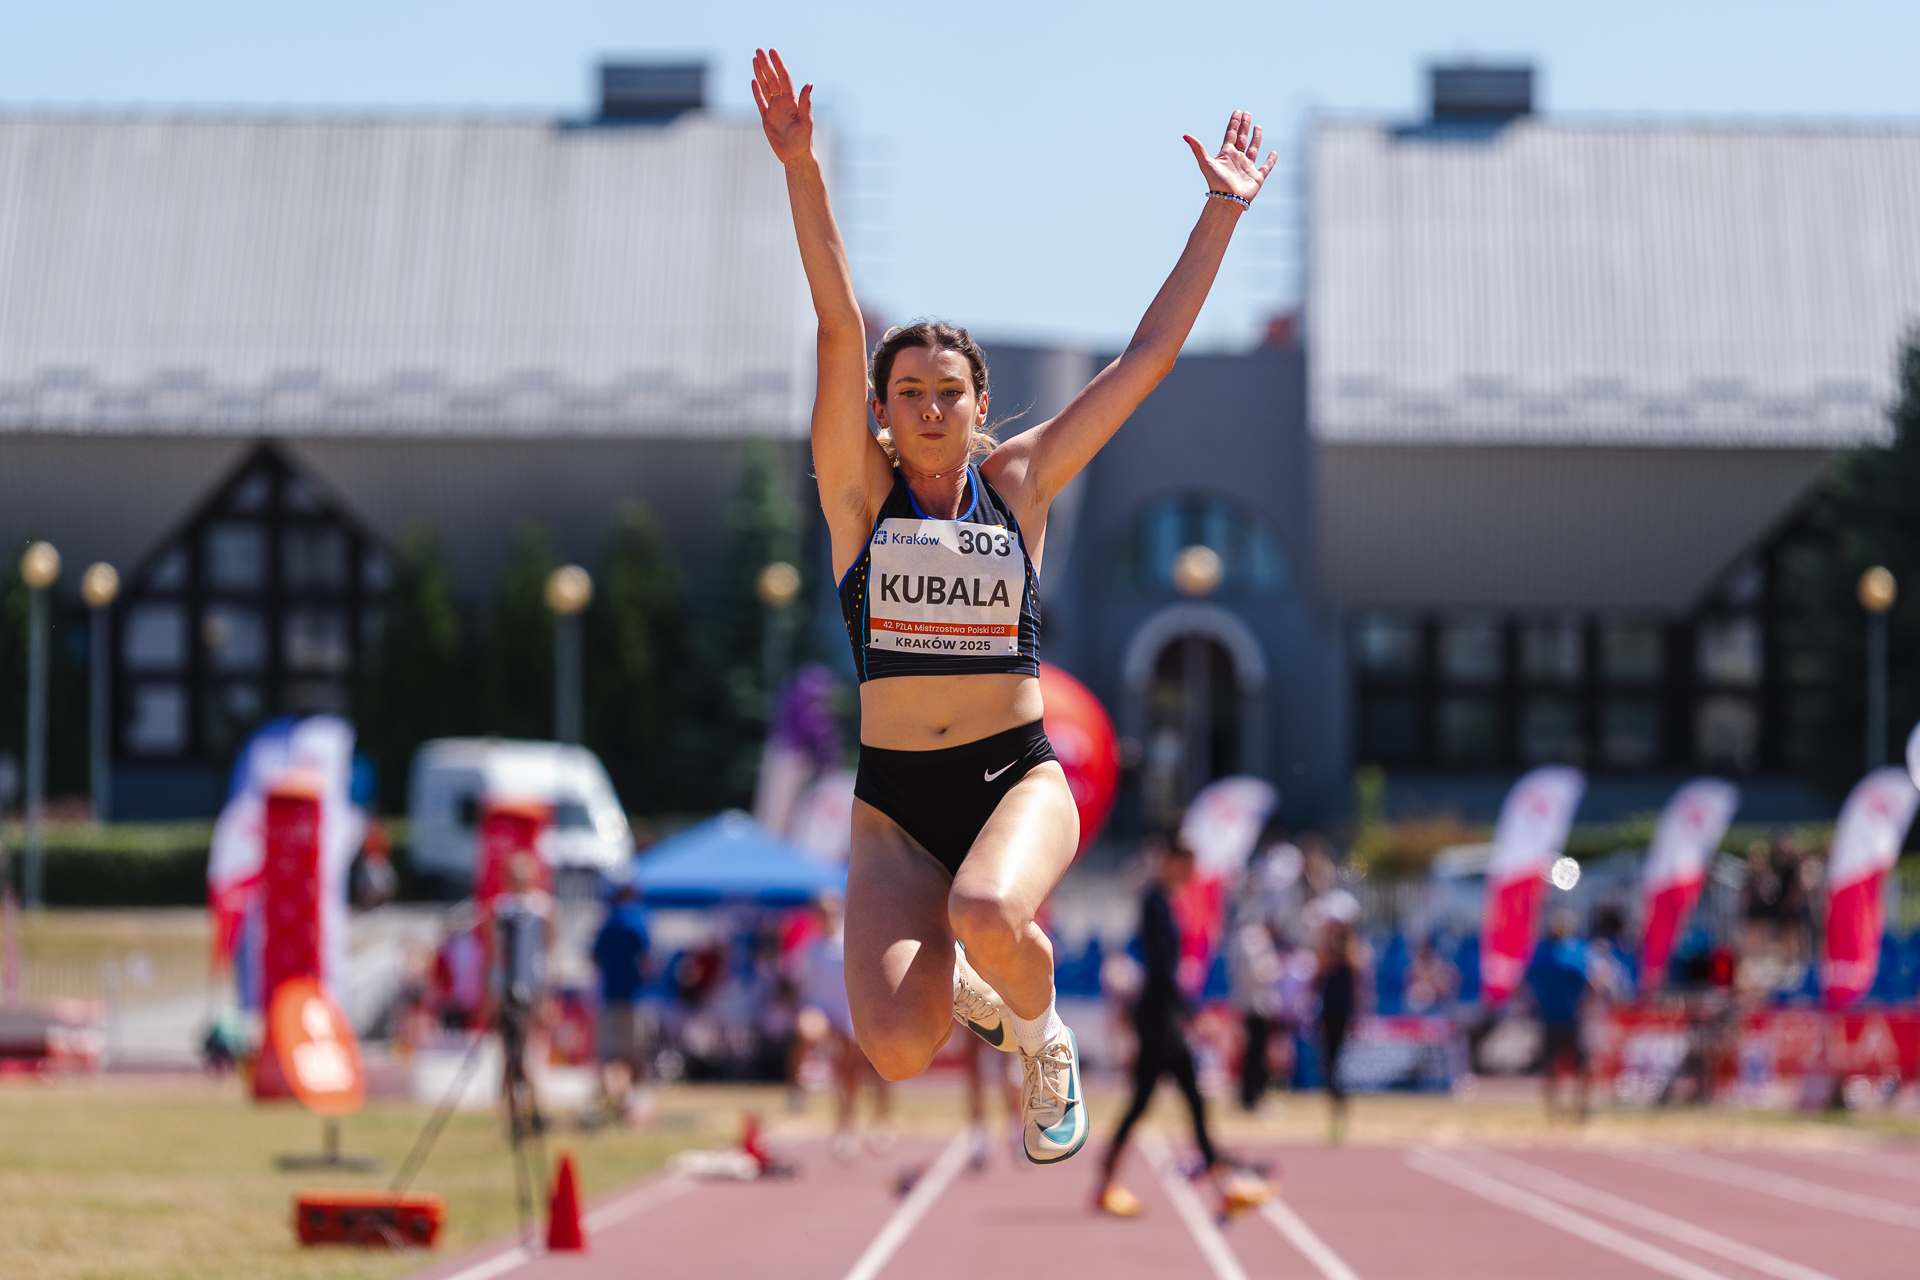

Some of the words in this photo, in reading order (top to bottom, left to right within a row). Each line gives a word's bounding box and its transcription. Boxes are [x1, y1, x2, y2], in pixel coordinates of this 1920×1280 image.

[892, 532, 940, 546] Kraków
[958, 530, 1011, 557] 303
[881, 573, 1010, 608] KUBALA
[883, 621, 895, 629] 42.
[895, 622, 913, 631] PZLA
[914, 623, 966, 634] Mistrzostwa
[967, 626, 990, 634] Polski
[990, 626, 1006, 634] U23
[895, 636, 957, 650] KRAKÓW
[959, 640, 991, 651] 2025
